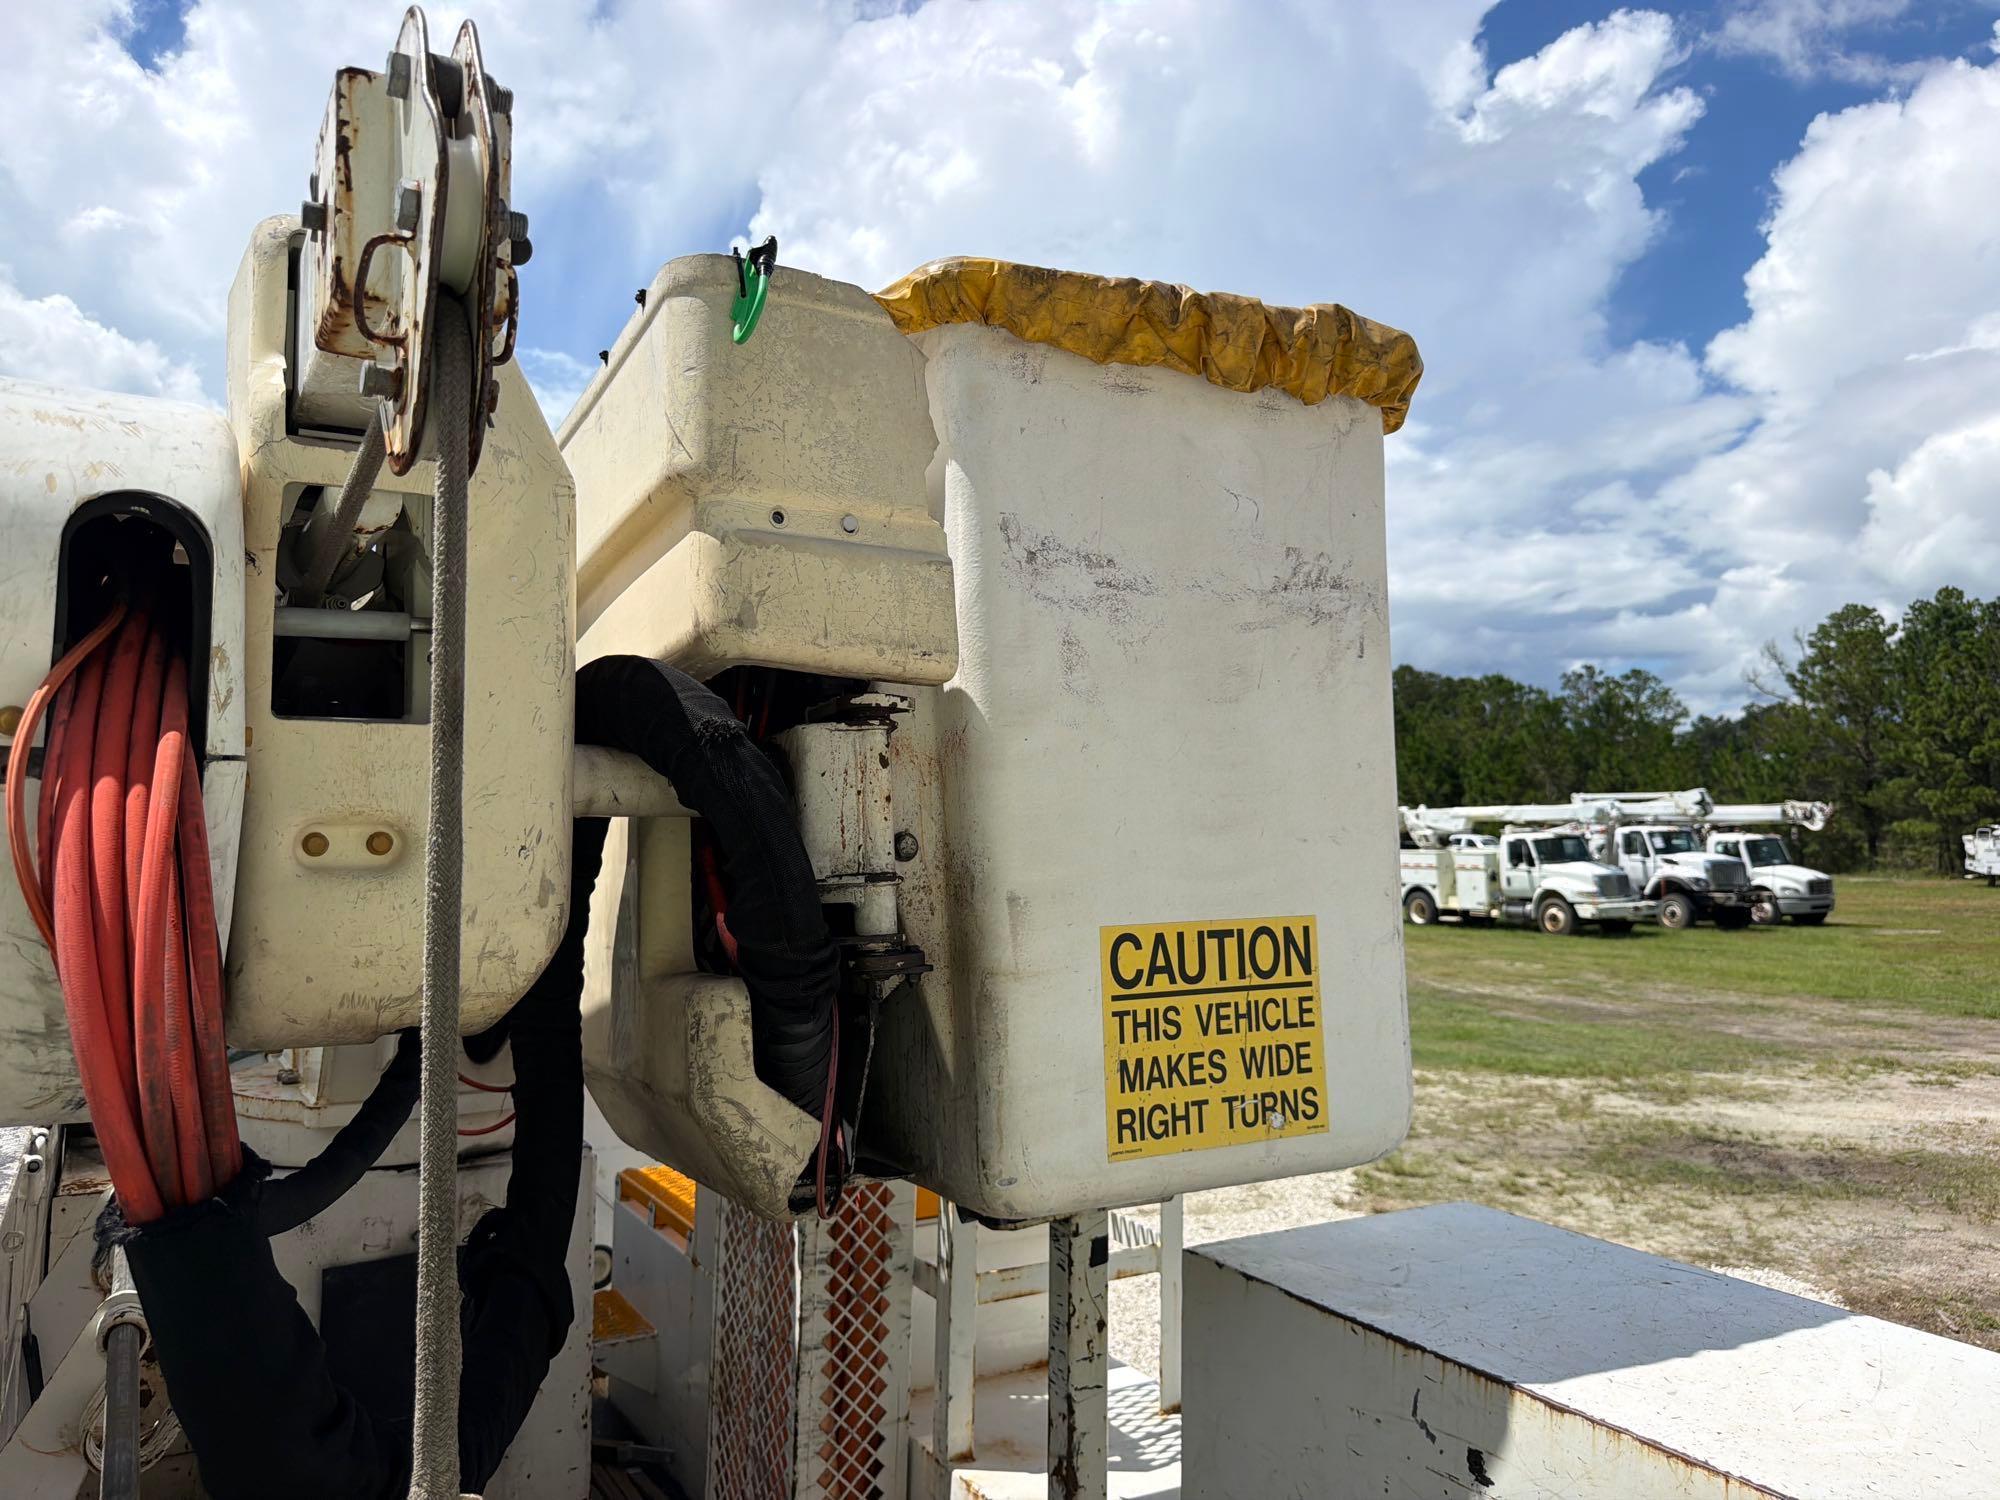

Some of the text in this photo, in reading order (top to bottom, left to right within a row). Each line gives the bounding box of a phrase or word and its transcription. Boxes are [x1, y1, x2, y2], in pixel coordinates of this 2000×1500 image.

[1110, 926, 1312, 989] CAUTION
[1112, 996, 1315, 1044] THIS VEHICLE
[1120, 1042, 1312, 1094] MAKES WIDE
[1117, 1087, 1319, 1144] RIGHT TURNS
